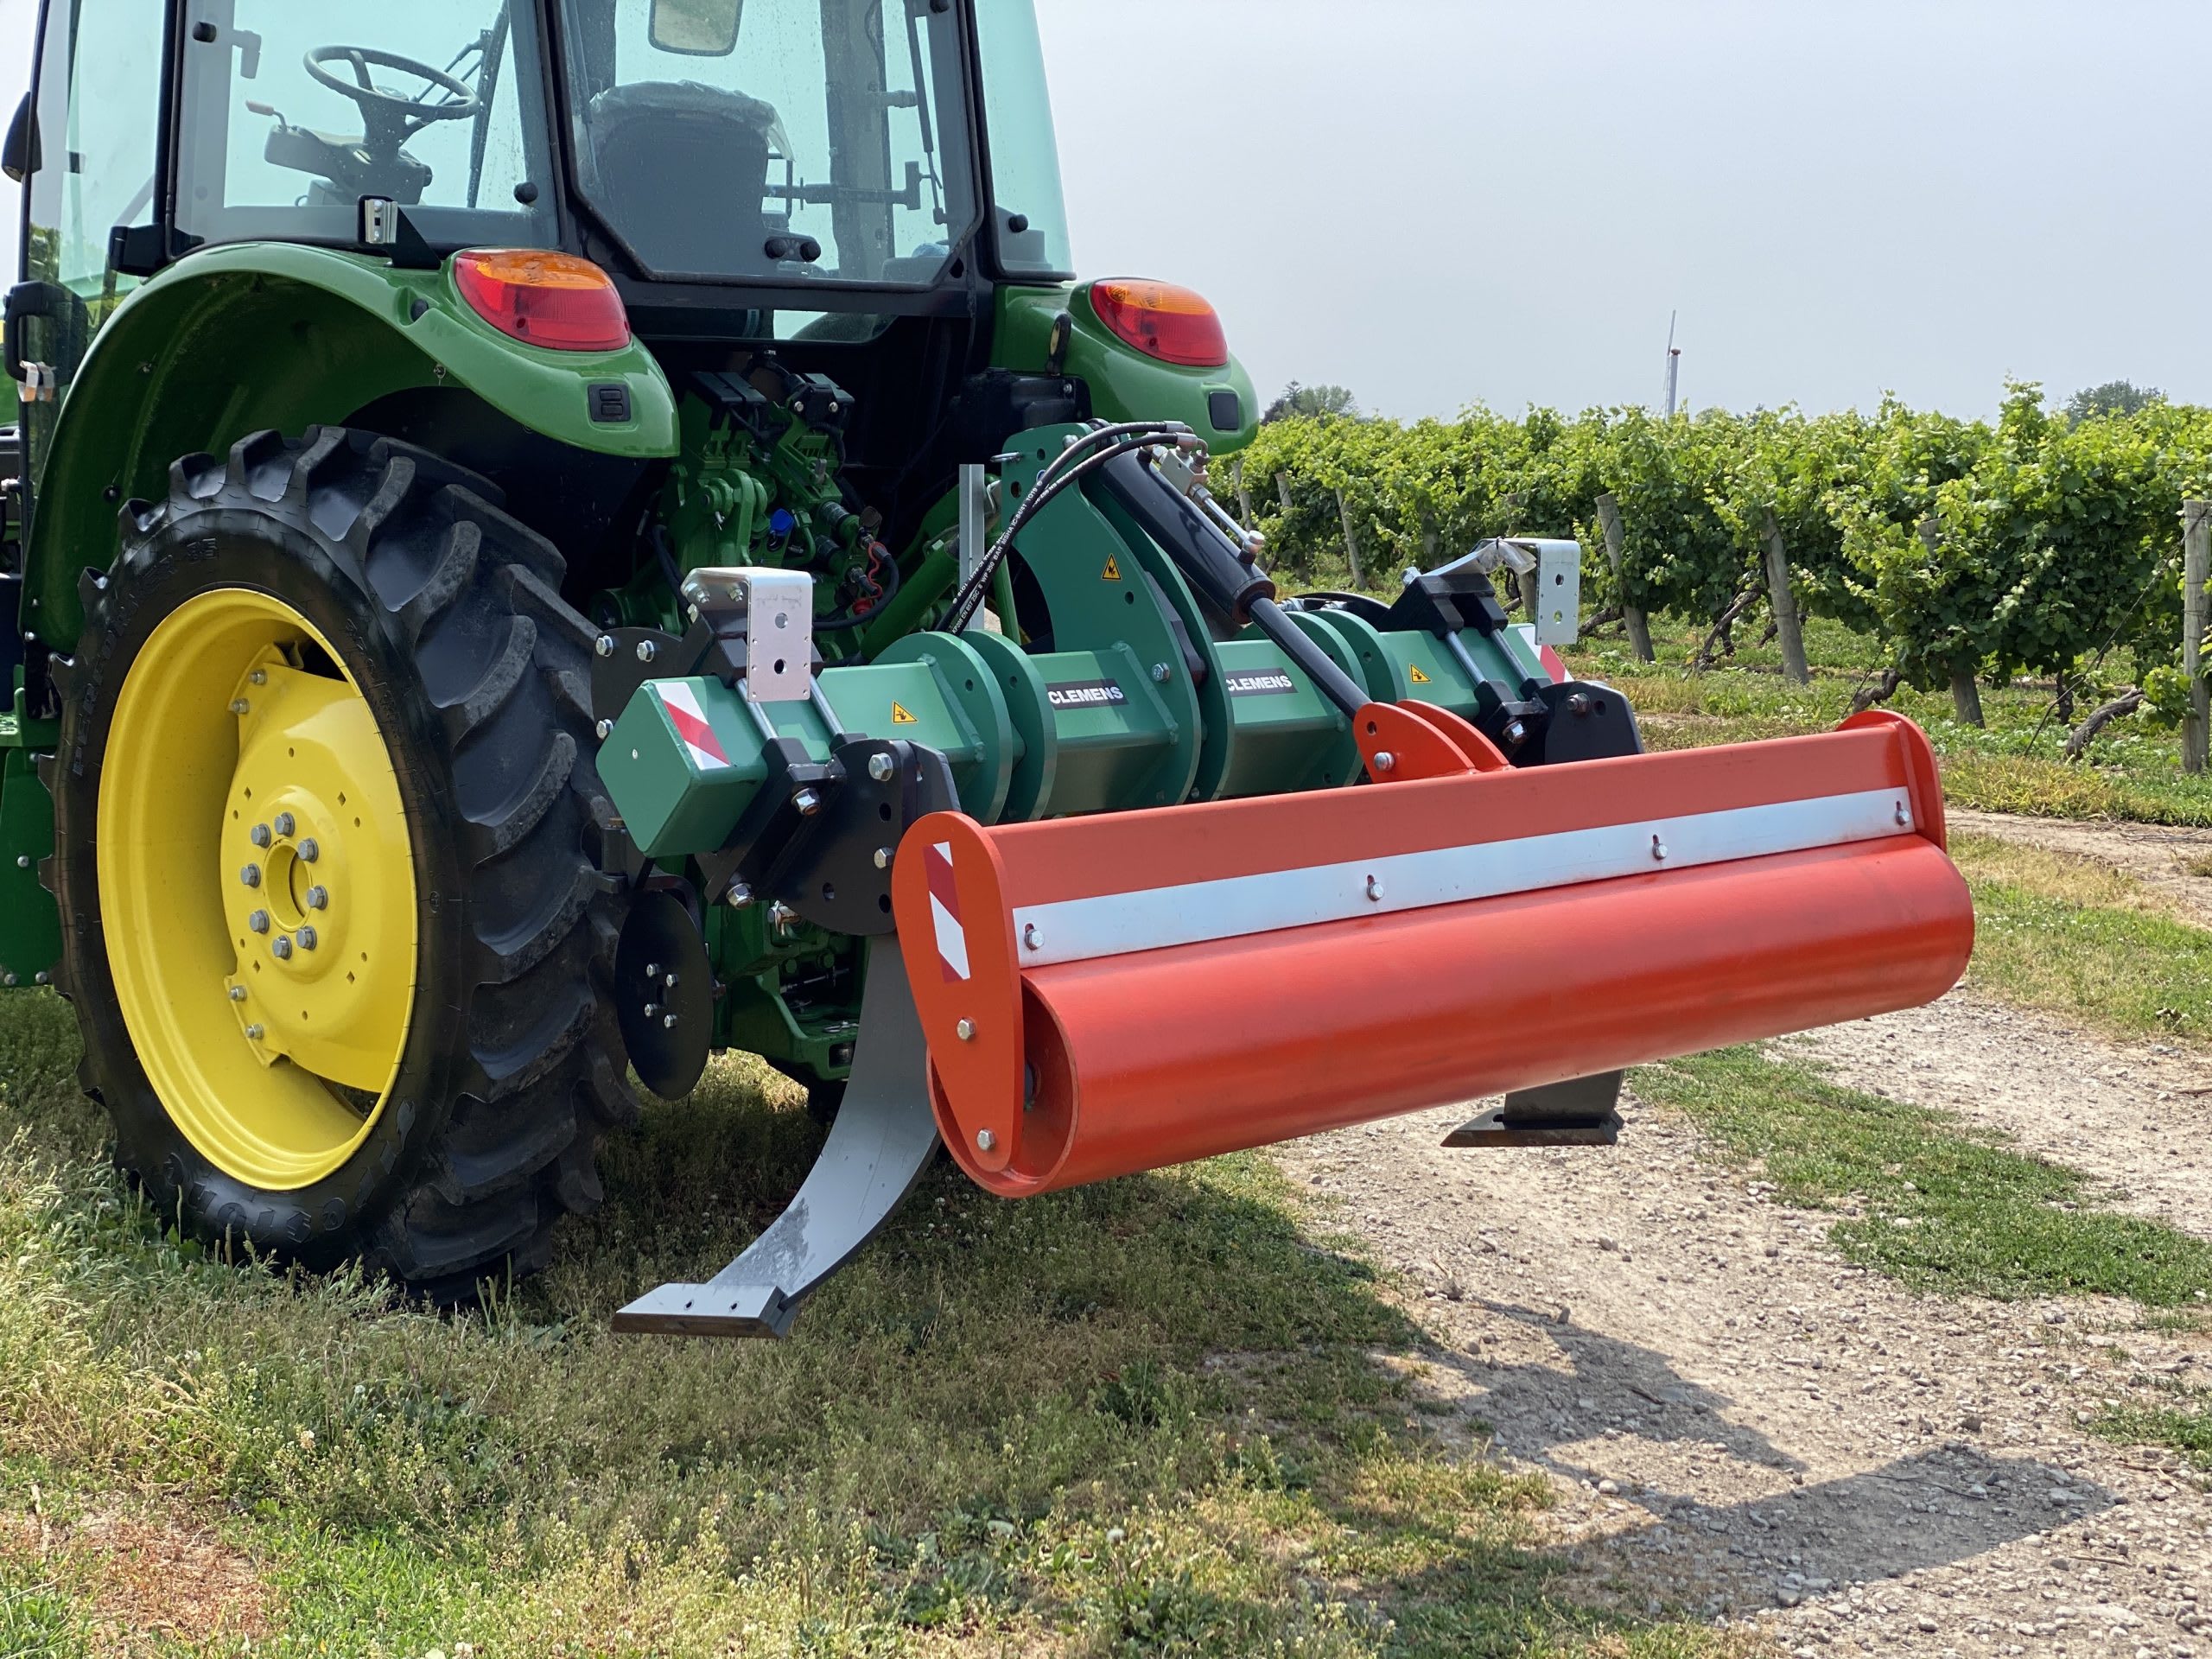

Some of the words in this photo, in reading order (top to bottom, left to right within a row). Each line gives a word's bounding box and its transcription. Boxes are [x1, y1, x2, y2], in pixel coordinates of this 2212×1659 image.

[981, 571, 989, 583] WP
[993, 545, 1003, 561] BAR
[1001, 525, 1014, 545] MSHA
[1225, 675, 1293, 691] CLEMENS
[1047, 686, 1124, 704] CLEMENS
